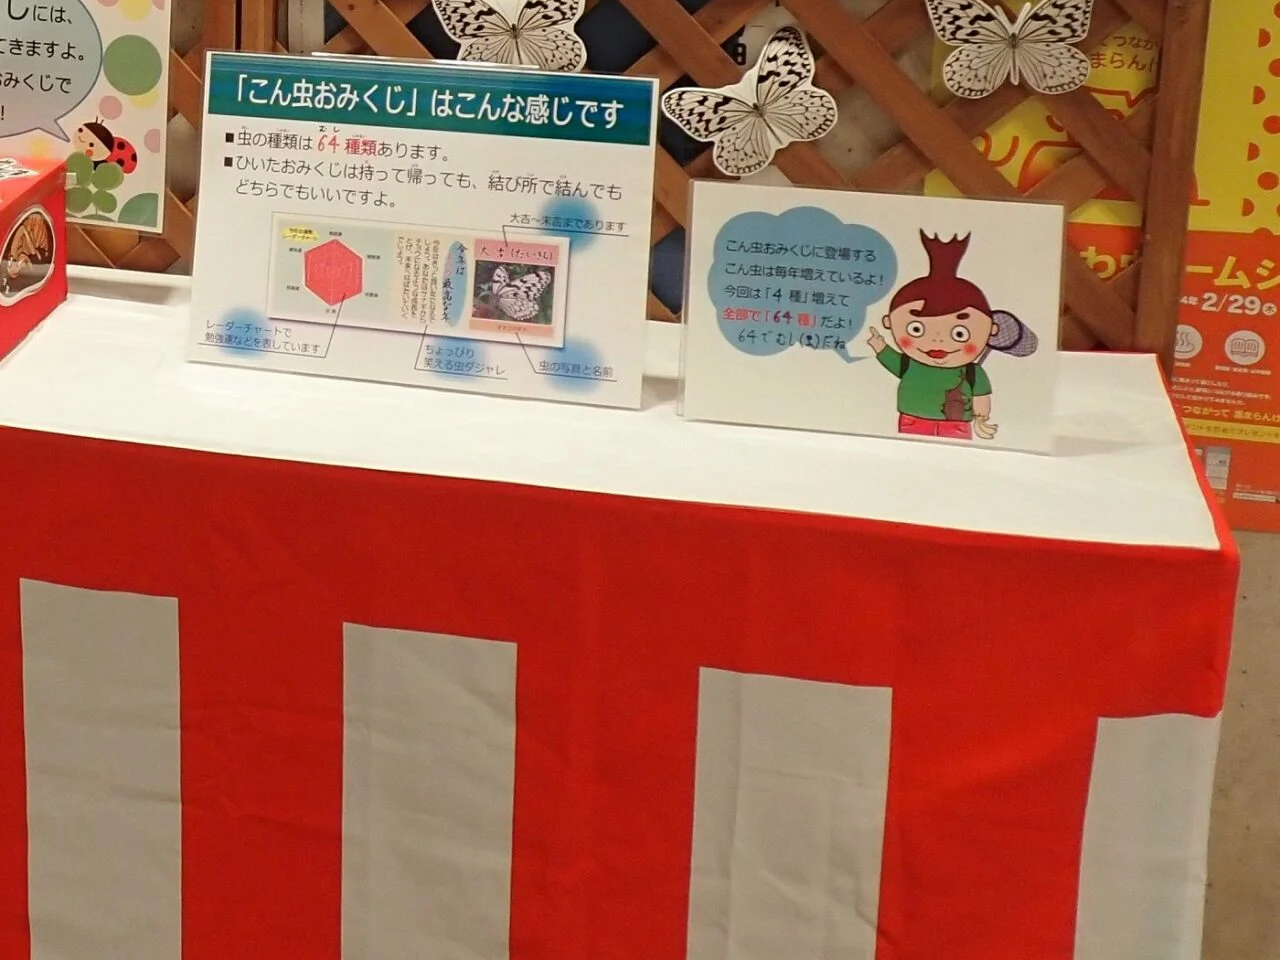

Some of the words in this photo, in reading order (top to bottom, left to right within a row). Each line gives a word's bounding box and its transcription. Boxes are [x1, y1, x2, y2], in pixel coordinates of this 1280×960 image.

[236, 74, 625, 130] 「こん虫おみくじ」はこんな感じです
[235, 178, 396, 208] どちらでもいいですよ。
[726, 240, 876, 262] こん虫おみくじに登場する
[206, 320, 291, 337] レーダーチャートで
